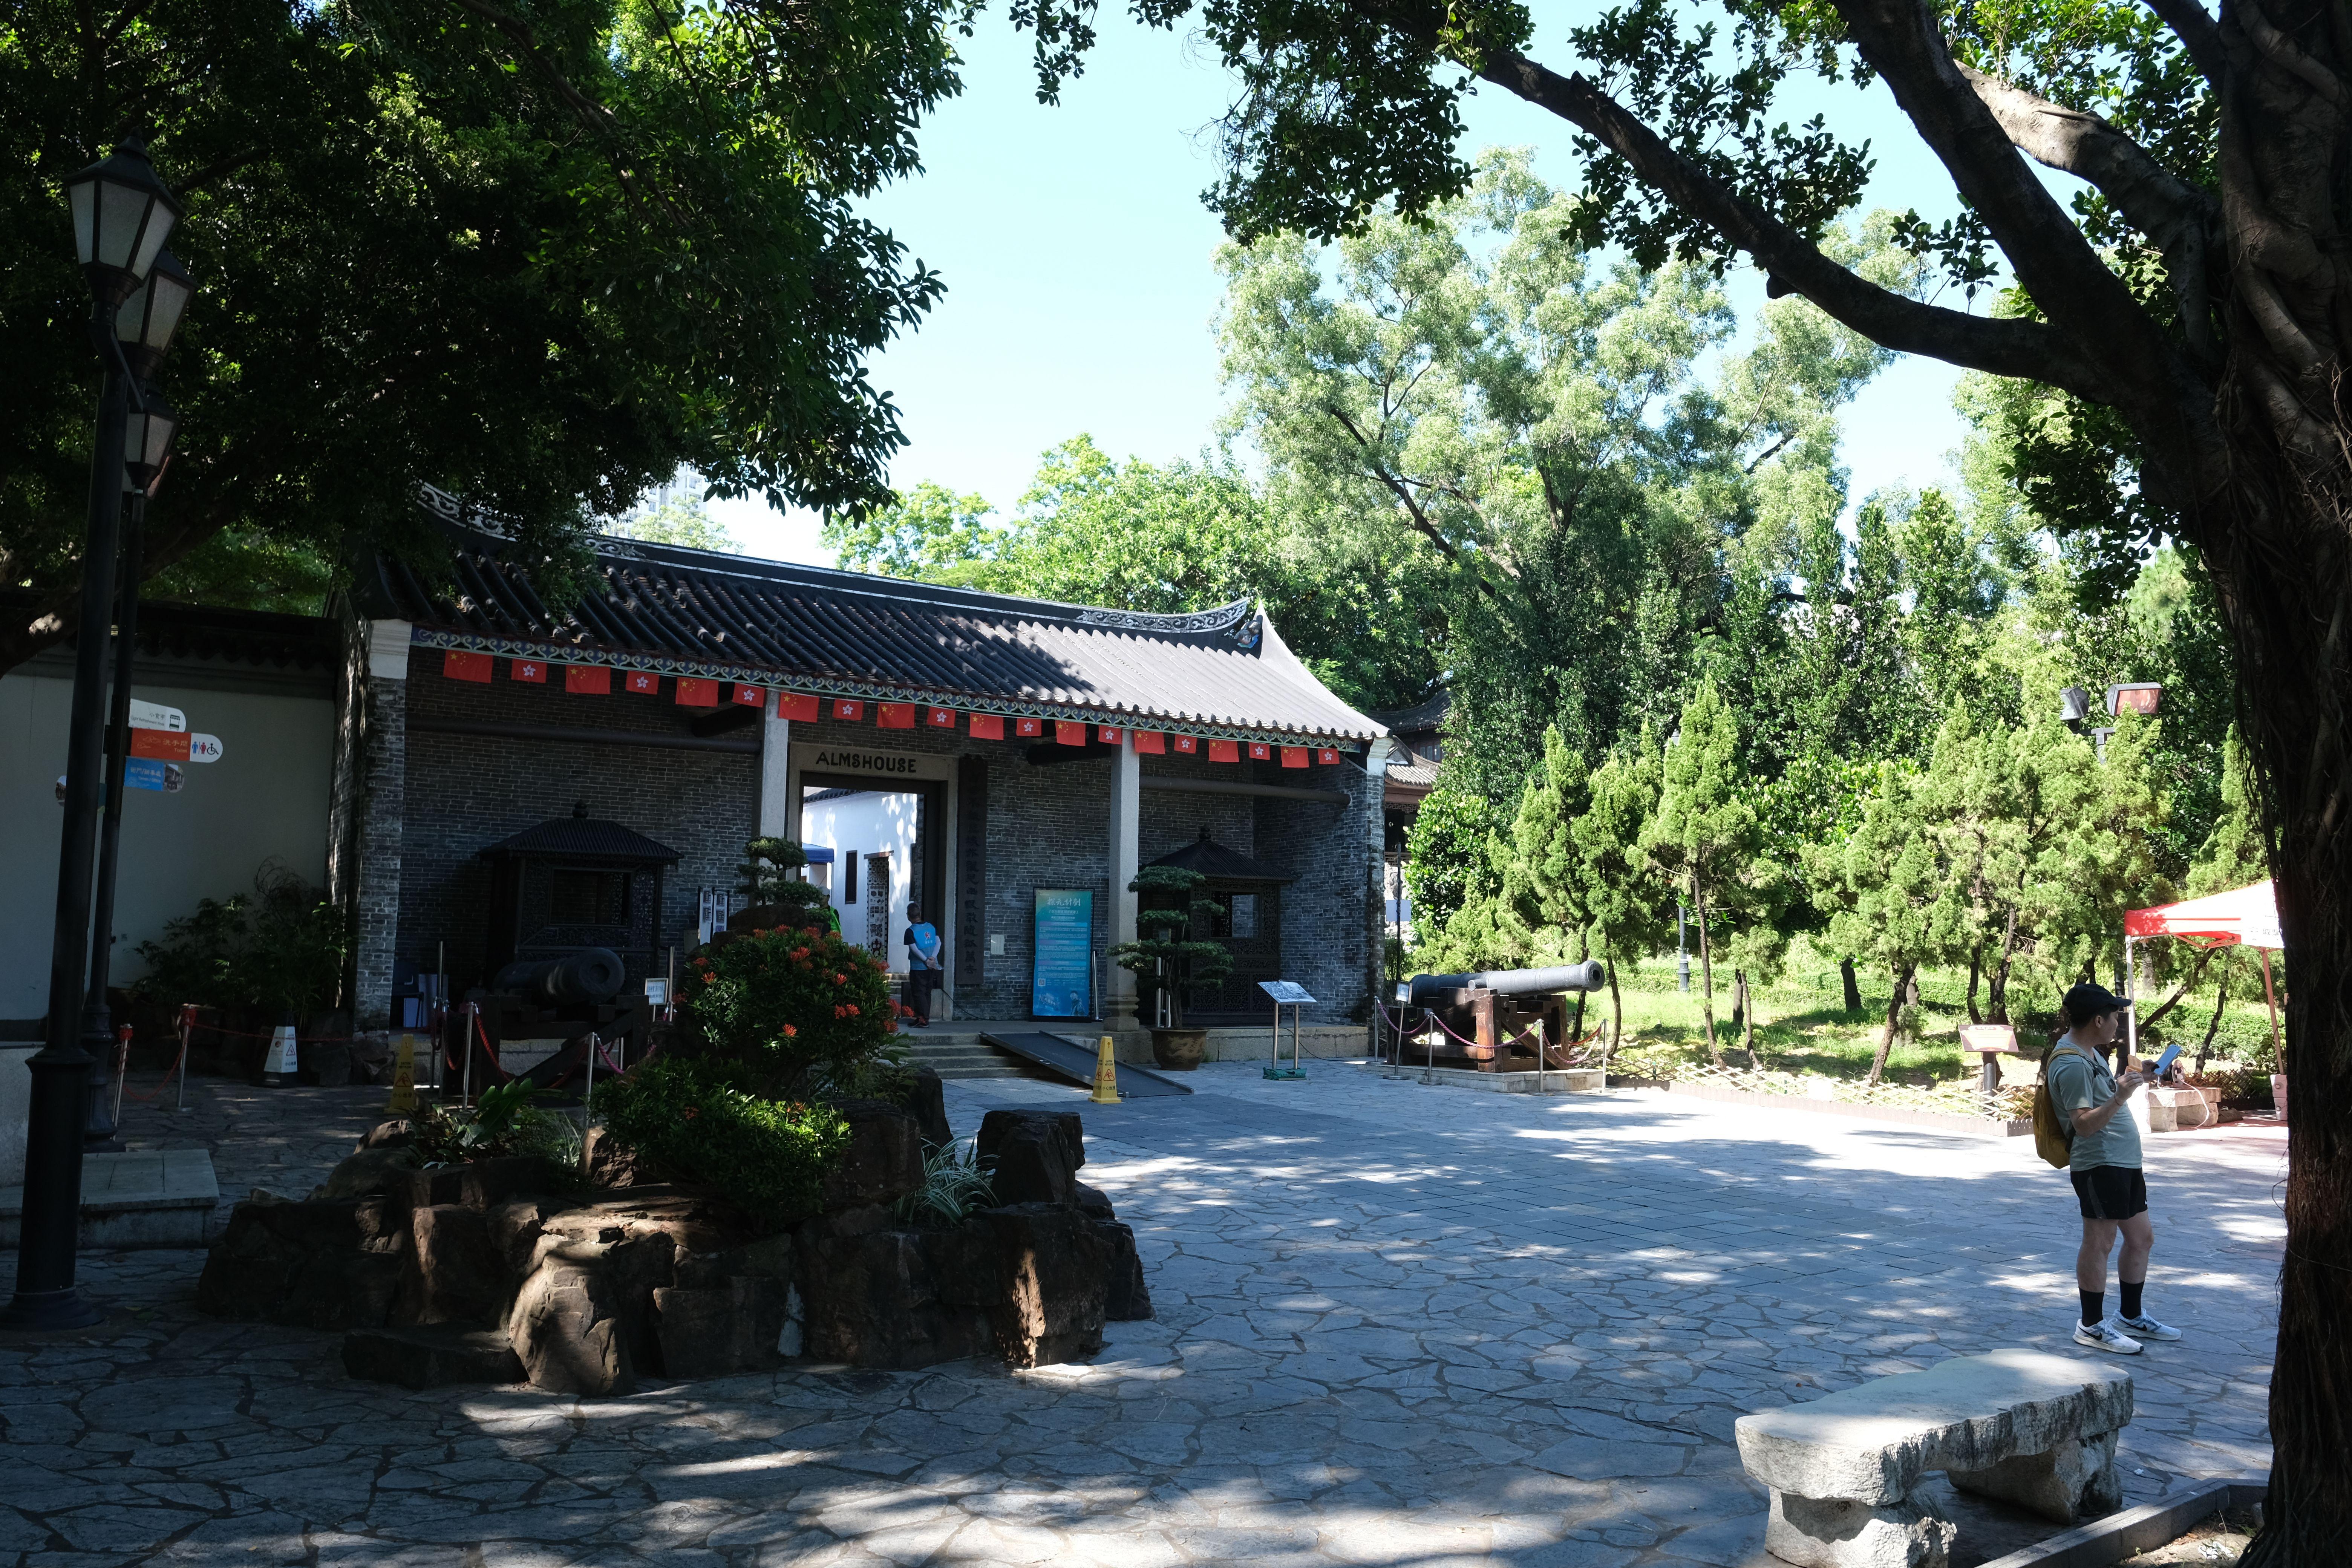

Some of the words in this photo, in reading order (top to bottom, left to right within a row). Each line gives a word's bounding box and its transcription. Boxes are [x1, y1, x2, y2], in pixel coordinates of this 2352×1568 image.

[163, 738, 188, 747] 洗手間
[816, 752, 916, 773] ALMSHOUSE
